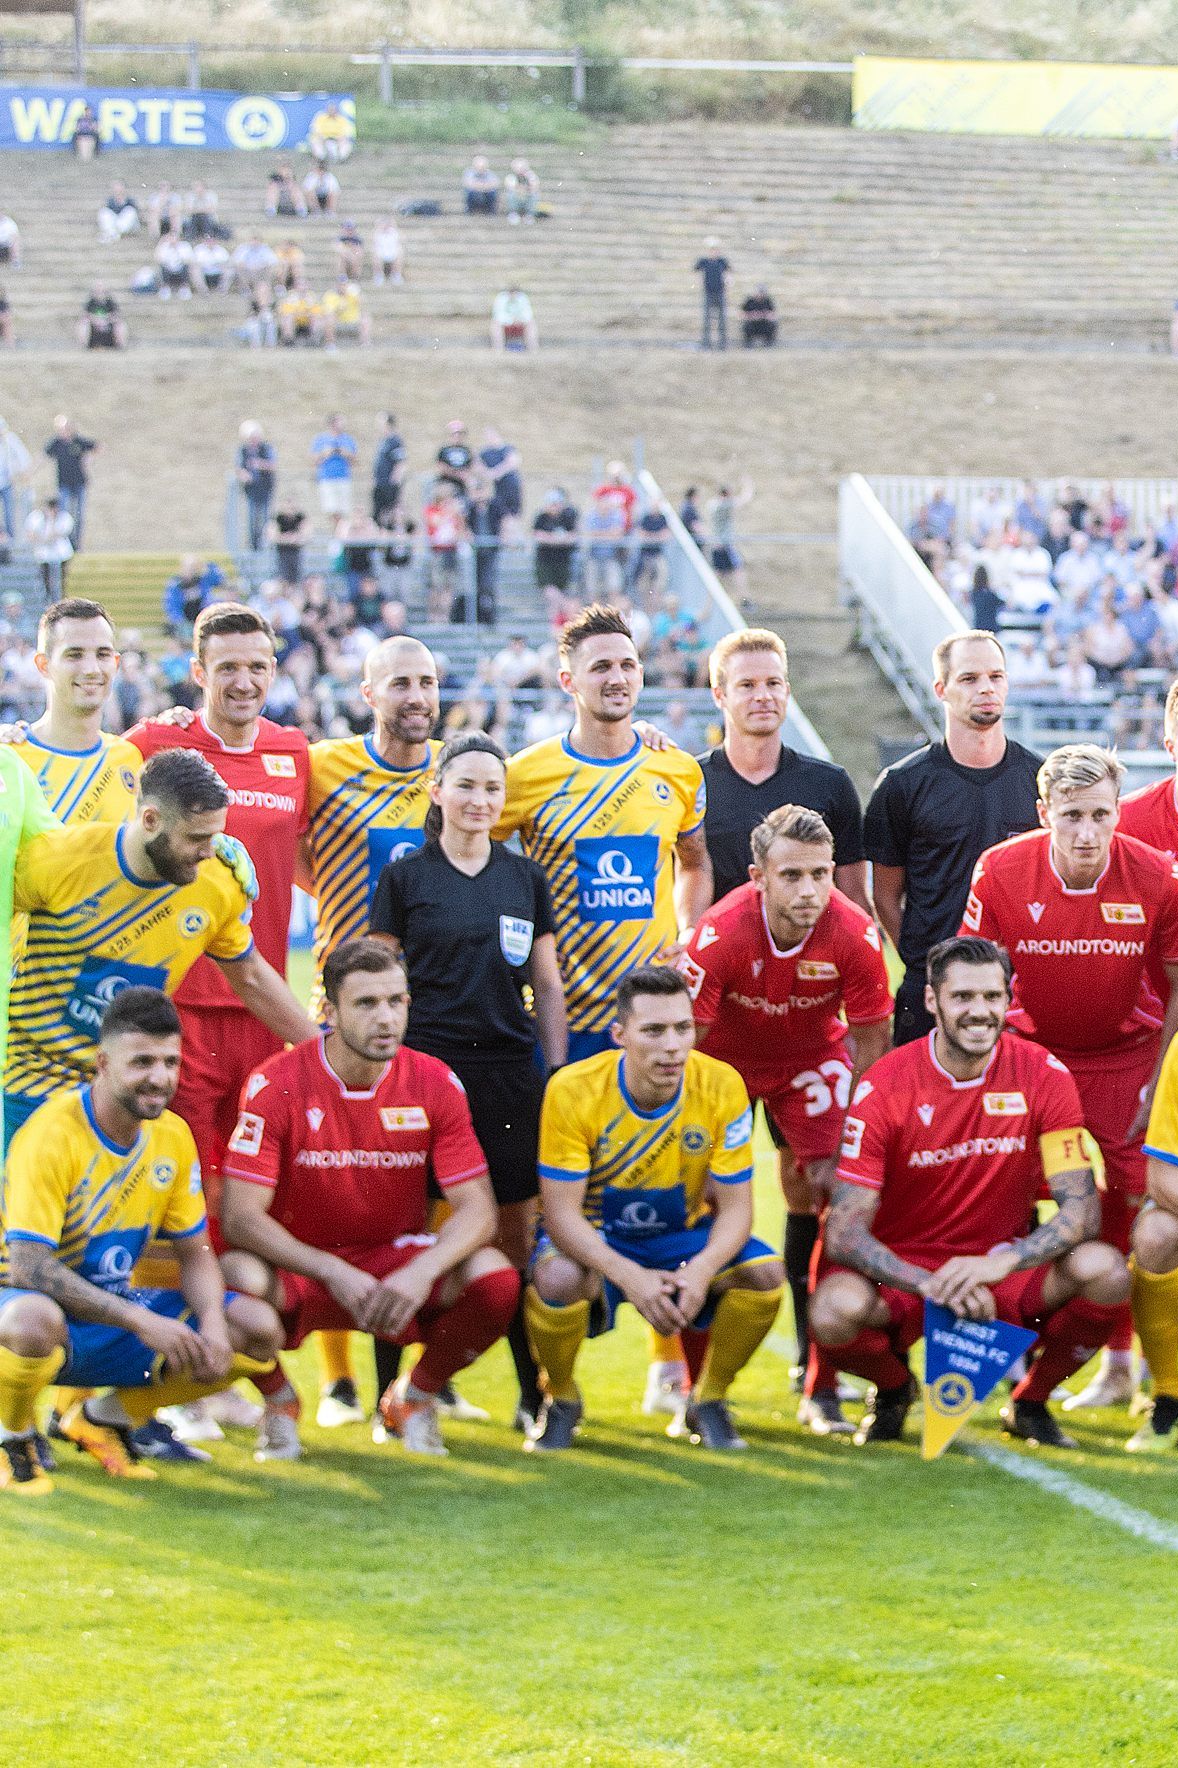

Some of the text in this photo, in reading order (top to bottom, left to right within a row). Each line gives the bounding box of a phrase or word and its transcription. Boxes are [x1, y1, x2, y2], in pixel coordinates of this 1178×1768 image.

[78, 800, 94, 821] 125
[228, 790, 297, 812] NDTOWN
[593, 779, 644, 831] 125 JAHRE
[583, 887, 653, 910] UNIQA
[111, 904, 174, 956] 125 JAHRE
[1016, 938, 1145, 956] AROUNDTOWN
[295, 1149, 428, 1169] AROUNDTOWN
[908, 1135, 1027, 1168] AROUNDTOWN
